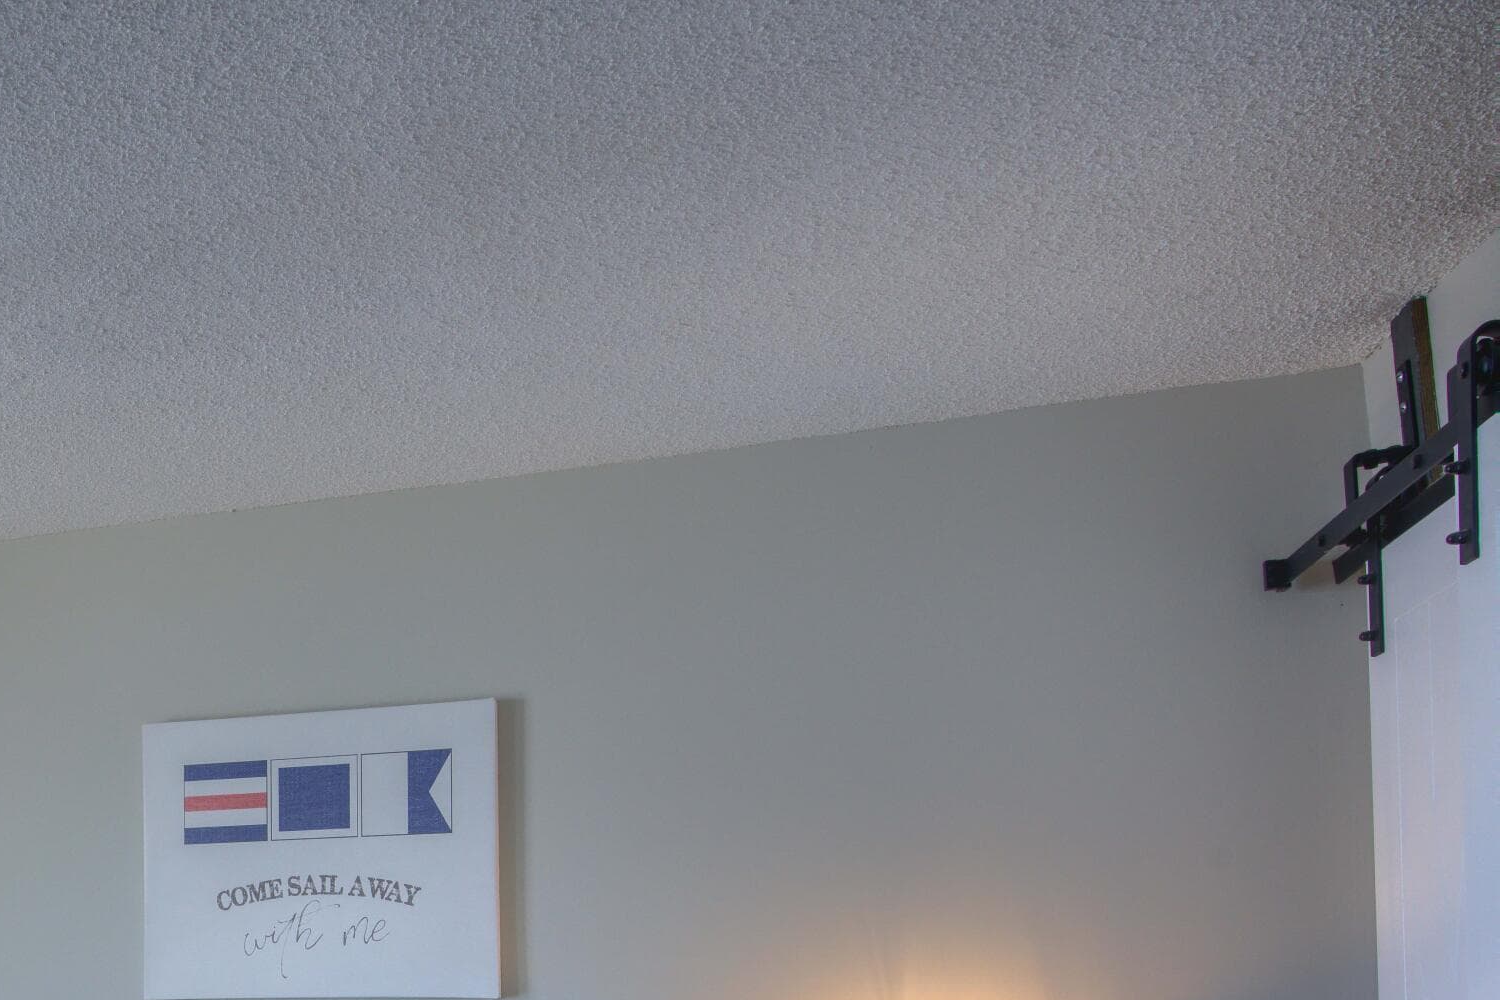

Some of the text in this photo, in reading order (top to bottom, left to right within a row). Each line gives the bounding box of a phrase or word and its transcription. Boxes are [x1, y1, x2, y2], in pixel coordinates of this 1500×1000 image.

[216, 874, 422, 911] COME SAIL AWAY
[243, 899, 390, 979] with me
